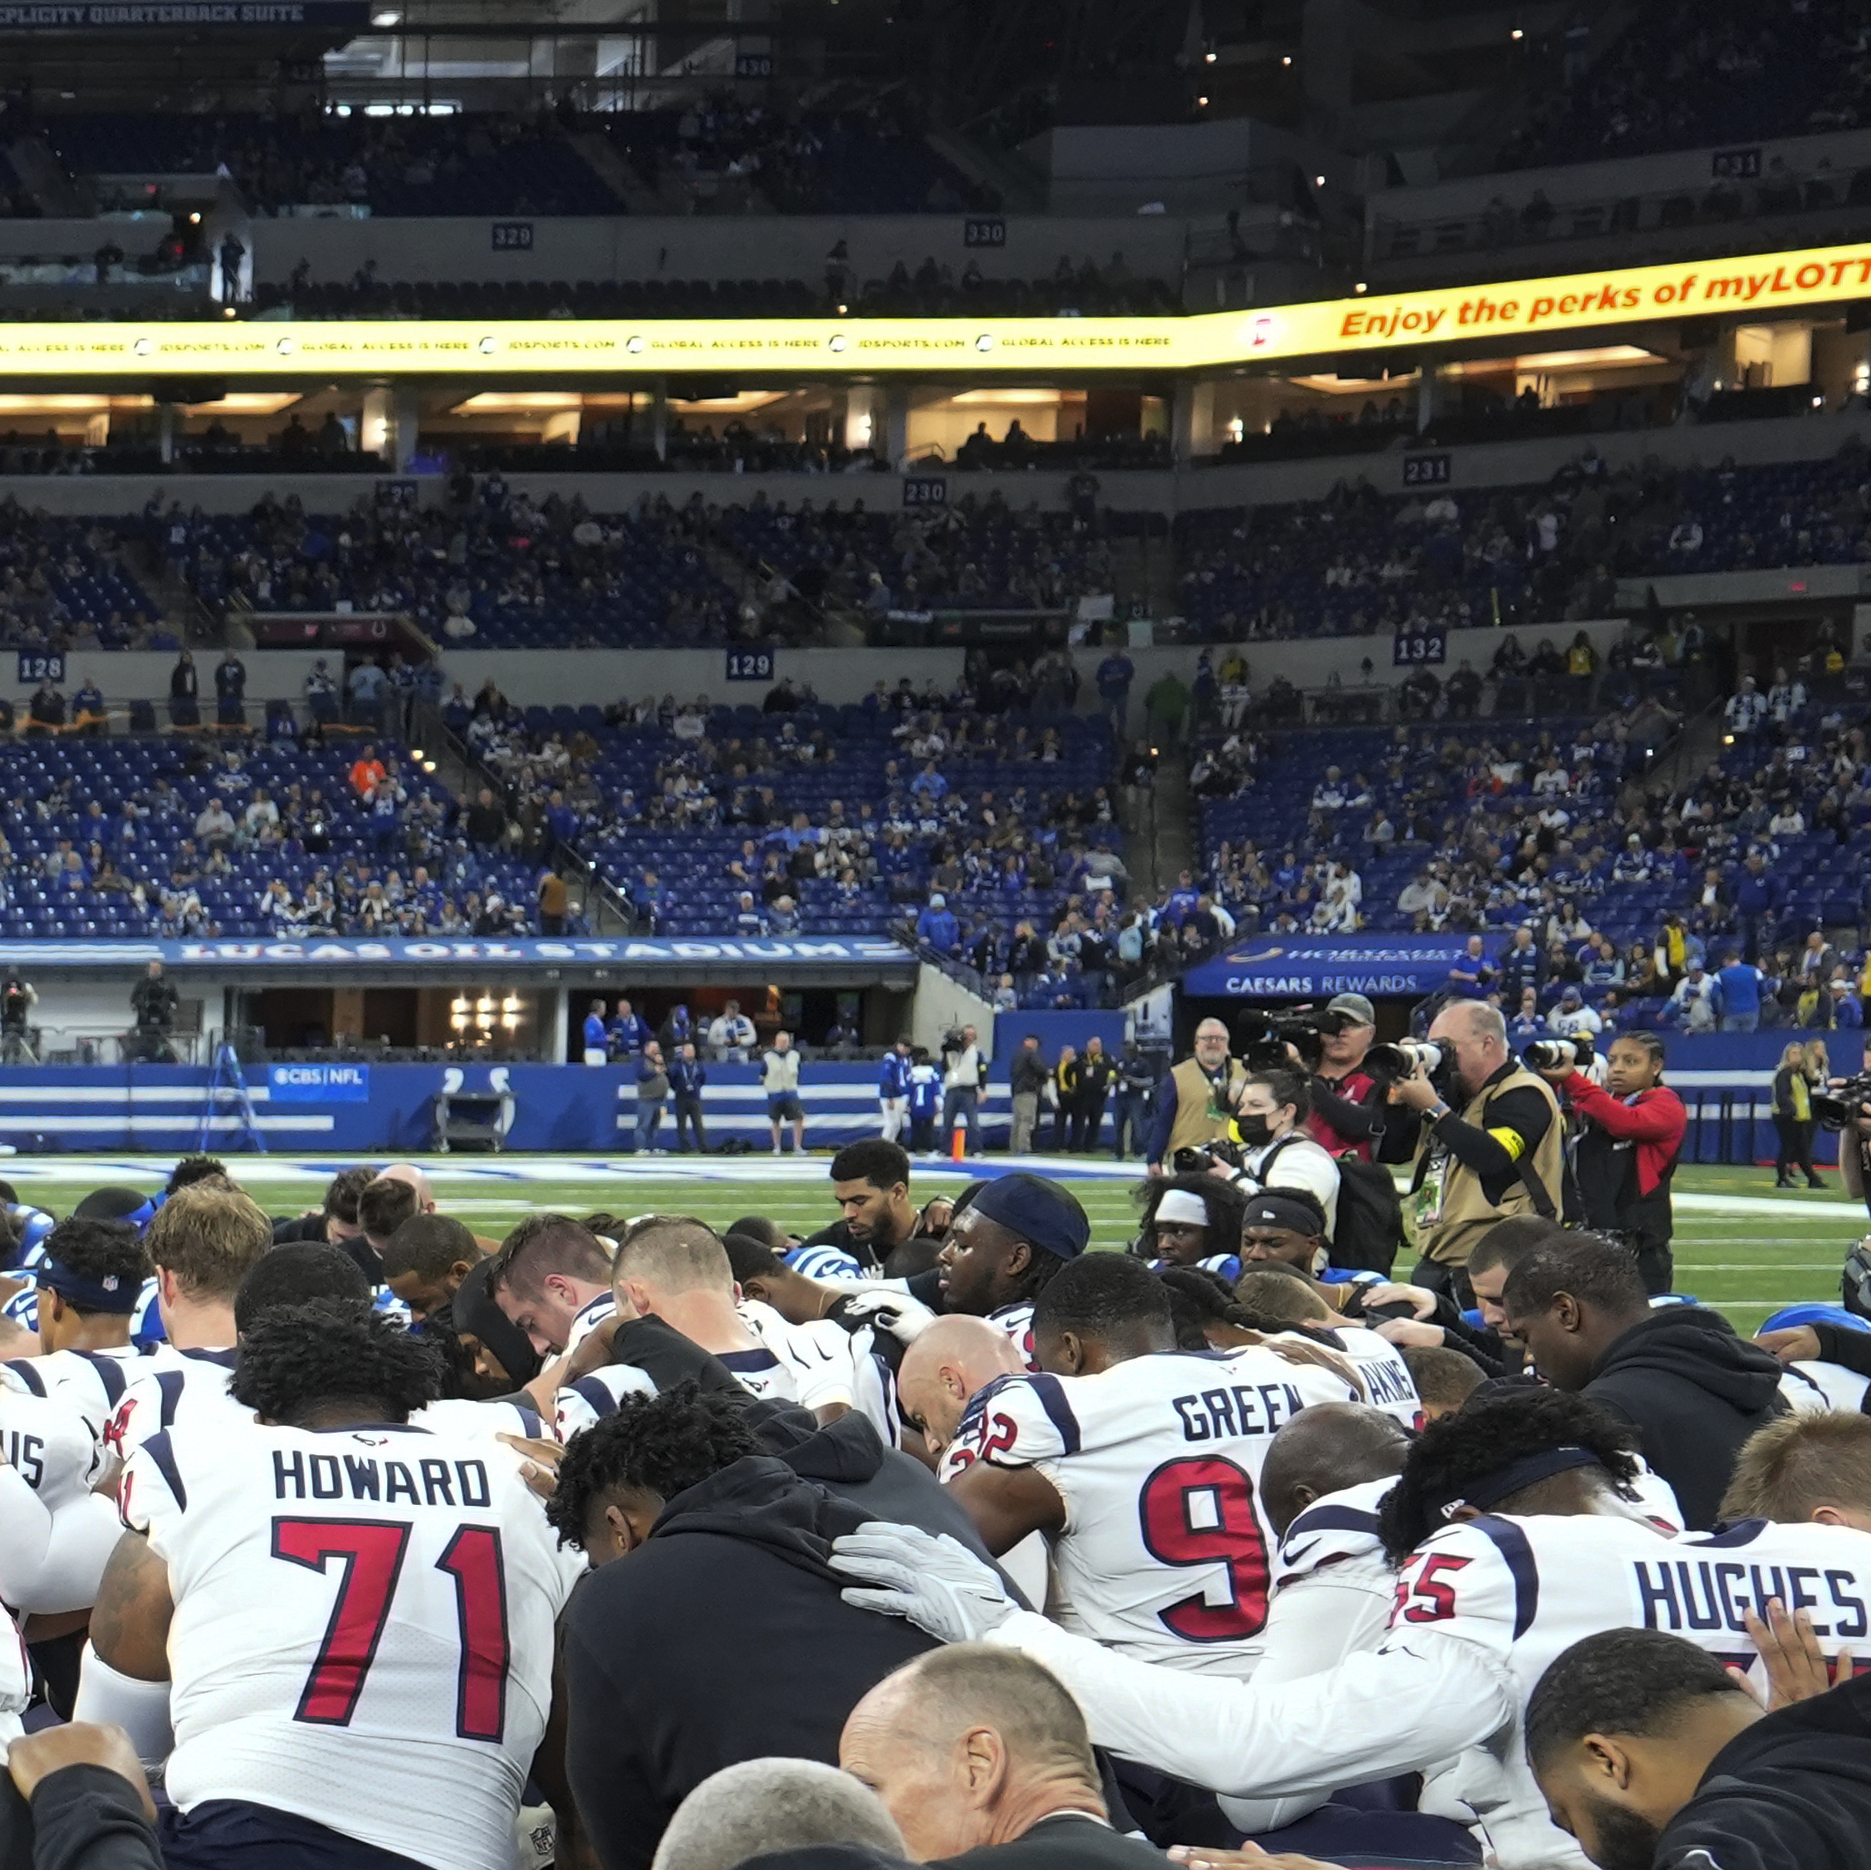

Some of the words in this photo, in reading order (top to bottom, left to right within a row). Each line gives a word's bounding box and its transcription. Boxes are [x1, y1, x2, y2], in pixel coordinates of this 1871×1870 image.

[89, 5, 235, 24] QUARTERBACK
[241, 6, 303, 23] SUITE
[1339, 304, 1446, 338] Enjoy
[1458, 299, 1519, 325] the
[1528, 283, 1640, 323] perks
[1652, 275, 1699, 304] of
[1135, 338, 1170, 347] HERE
[1407, 458, 1448, 482] 231
[906, 484, 944, 501] 230
[1394, 640, 1442, 659] 132
[729, 655, 770, 674] 129
[180, 943, 391, 959] LUCAS
[403, 943, 522, 958] OIL
[535, 942, 851, 959] STADIUM
[1226, 976, 1313, 994] CAESARS
[1321, 975, 1418, 994] REWARDS
[286, 1067, 322, 1084] CBS
[330, 1066, 363, 1086] NFL
[1173, 1383, 1305, 1442] GREEN
[271, 1449, 492, 1508] HOWARD
[1633, 1560, 1870, 1639] HUGHES
[269, 1515, 511, 1744] 71
